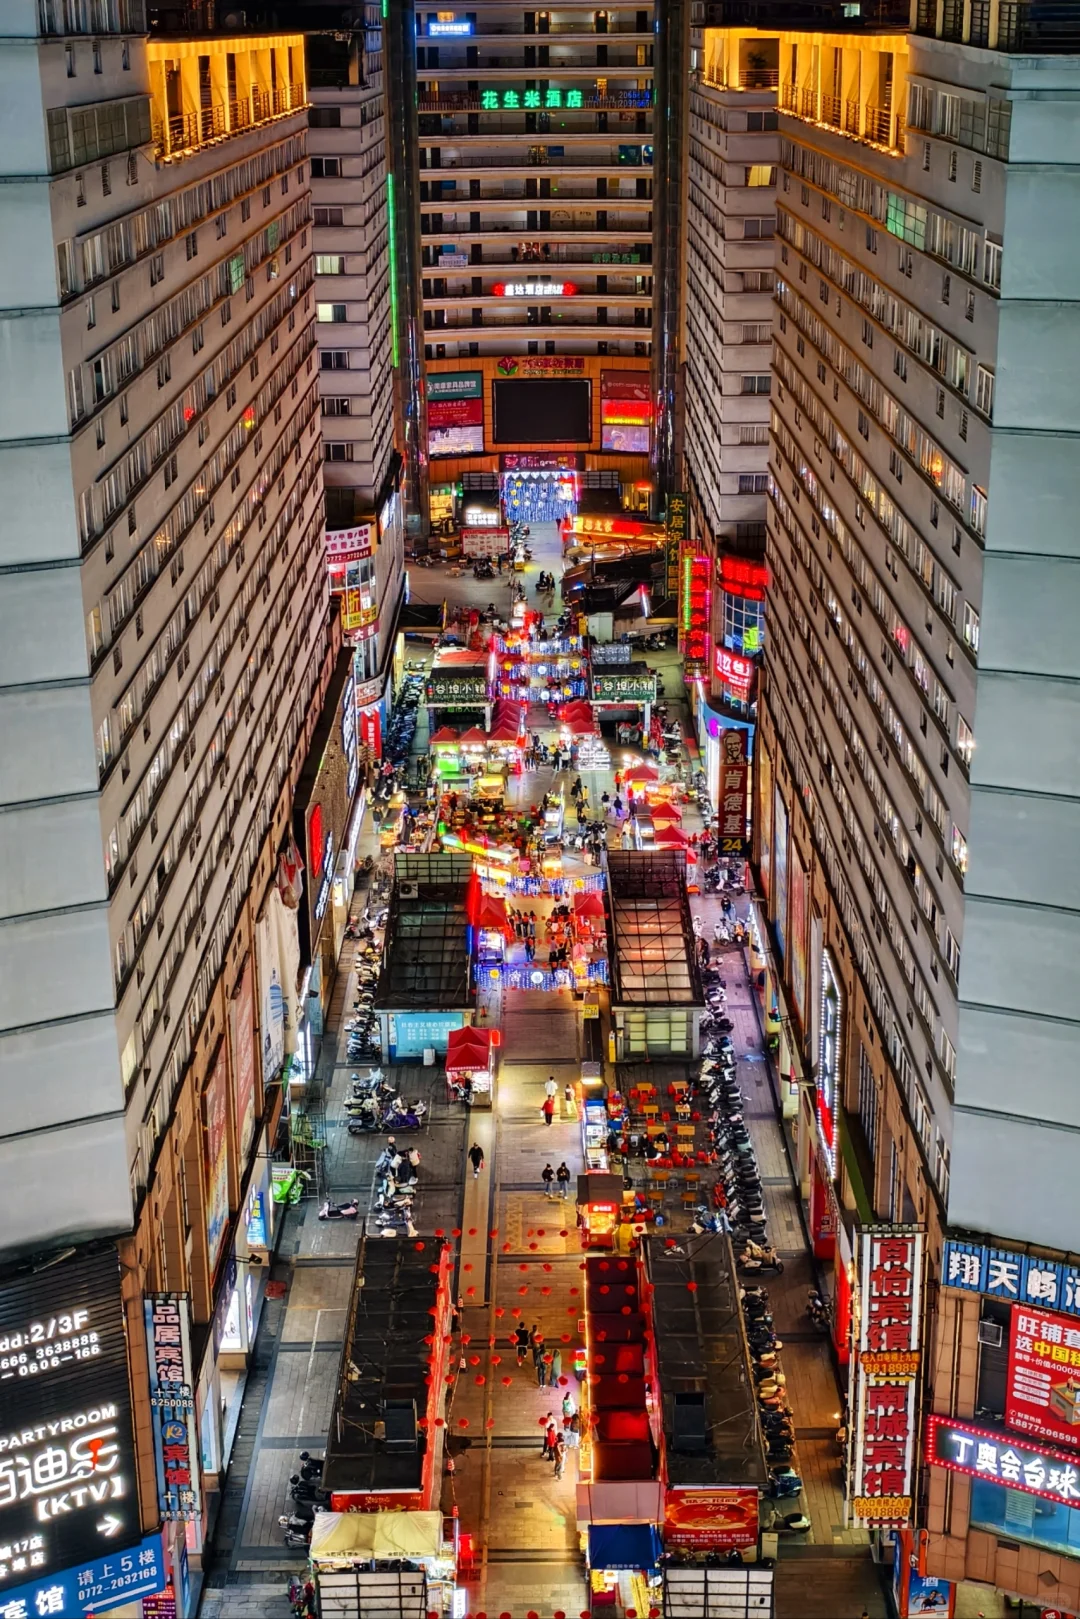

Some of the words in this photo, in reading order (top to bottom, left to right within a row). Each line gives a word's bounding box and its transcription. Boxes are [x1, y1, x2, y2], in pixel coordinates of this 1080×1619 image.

[481, 89, 583, 109] 花生米酒店
[723, 769, 744, 834] 肯德基
[722, 839, 743, 851] 24
[865, 1236, 916, 1350] 百怡宾馆
[36, 1331, 99, 1360] 3638888
[152, 1305, 184, 1382] 品居宾馆
[864, 1363, 917, 1374] 8818989
[150, 1398, 194, 1408] 8250088
[166, 1424, 183, 1439] K2
[862, 1383, 910, 1495] 南城宾馆
[1009, 1416, 1079, 1444] 18877206598
[163, 1444, 191, 1485] 宾馆
[950, 1432, 1080, 1500] 丁奥会台球
[858, 1507, 908, 1518] 8818866
[78, 1565, 158, 1601] 0772-2032168
